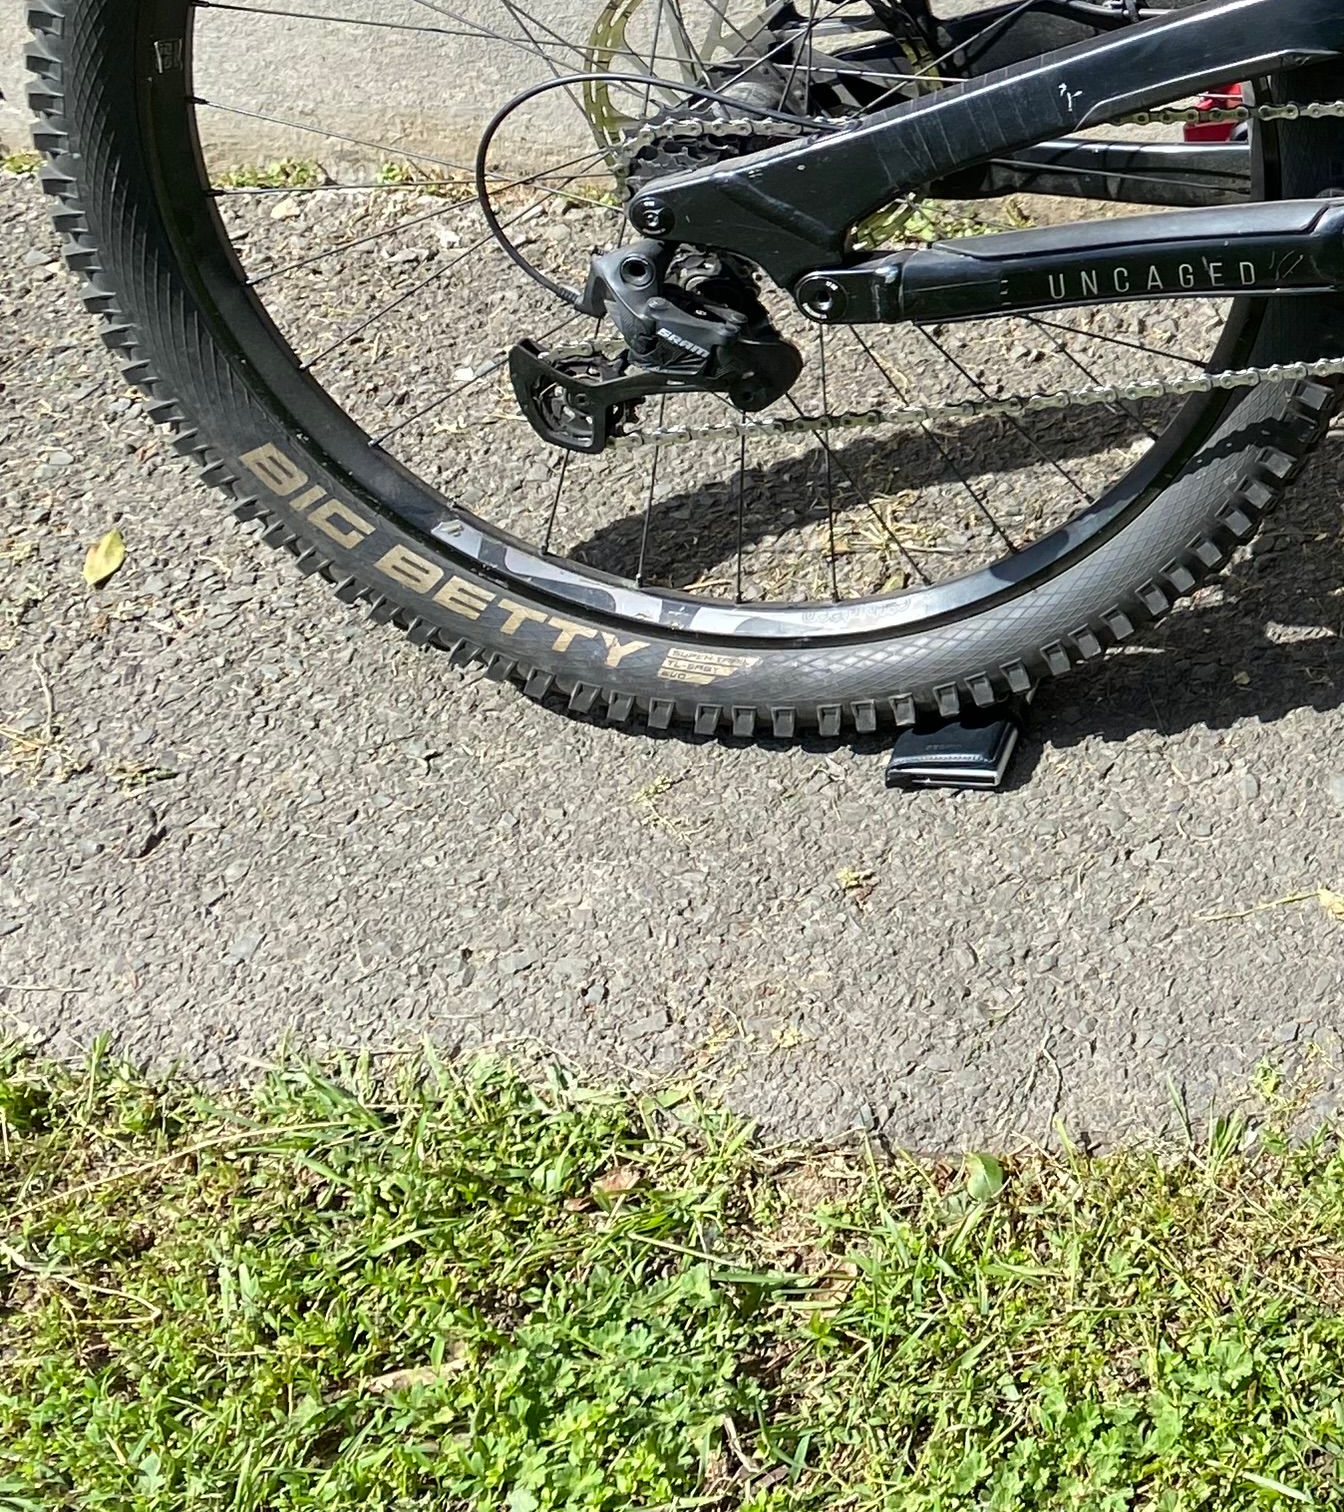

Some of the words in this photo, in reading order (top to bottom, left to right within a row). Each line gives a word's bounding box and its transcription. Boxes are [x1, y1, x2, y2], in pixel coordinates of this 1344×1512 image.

[1049, 261, 1256, 299] UNCAGED
[656, 327, 711, 358] SRAM
[240, 442, 376, 549] BIG
[375, 544, 651, 668] BETTY
